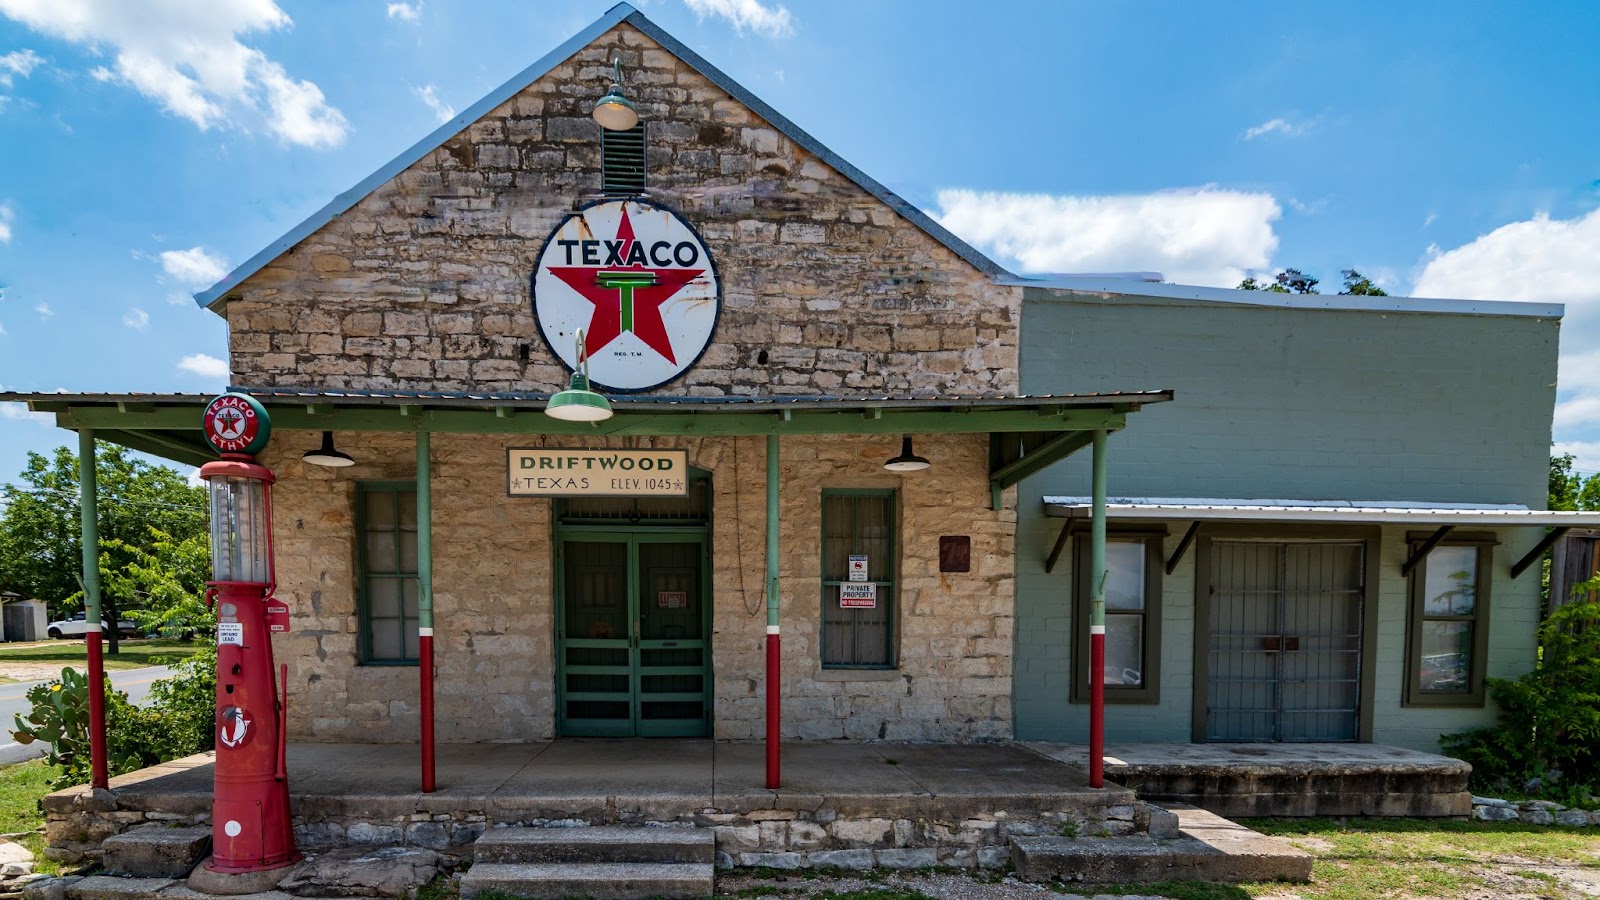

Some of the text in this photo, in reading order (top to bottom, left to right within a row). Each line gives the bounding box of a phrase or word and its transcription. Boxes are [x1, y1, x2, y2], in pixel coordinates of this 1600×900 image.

[557, 239, 699, 268] TEXACO
[206, 397, 255, 418] TEXACO
[210, 433, 254, 451] ETHYL
[520, 454, 673, 471] DRIFTWOOD
[523, 477, 671, 490] TEXAS ELEV. 1045
